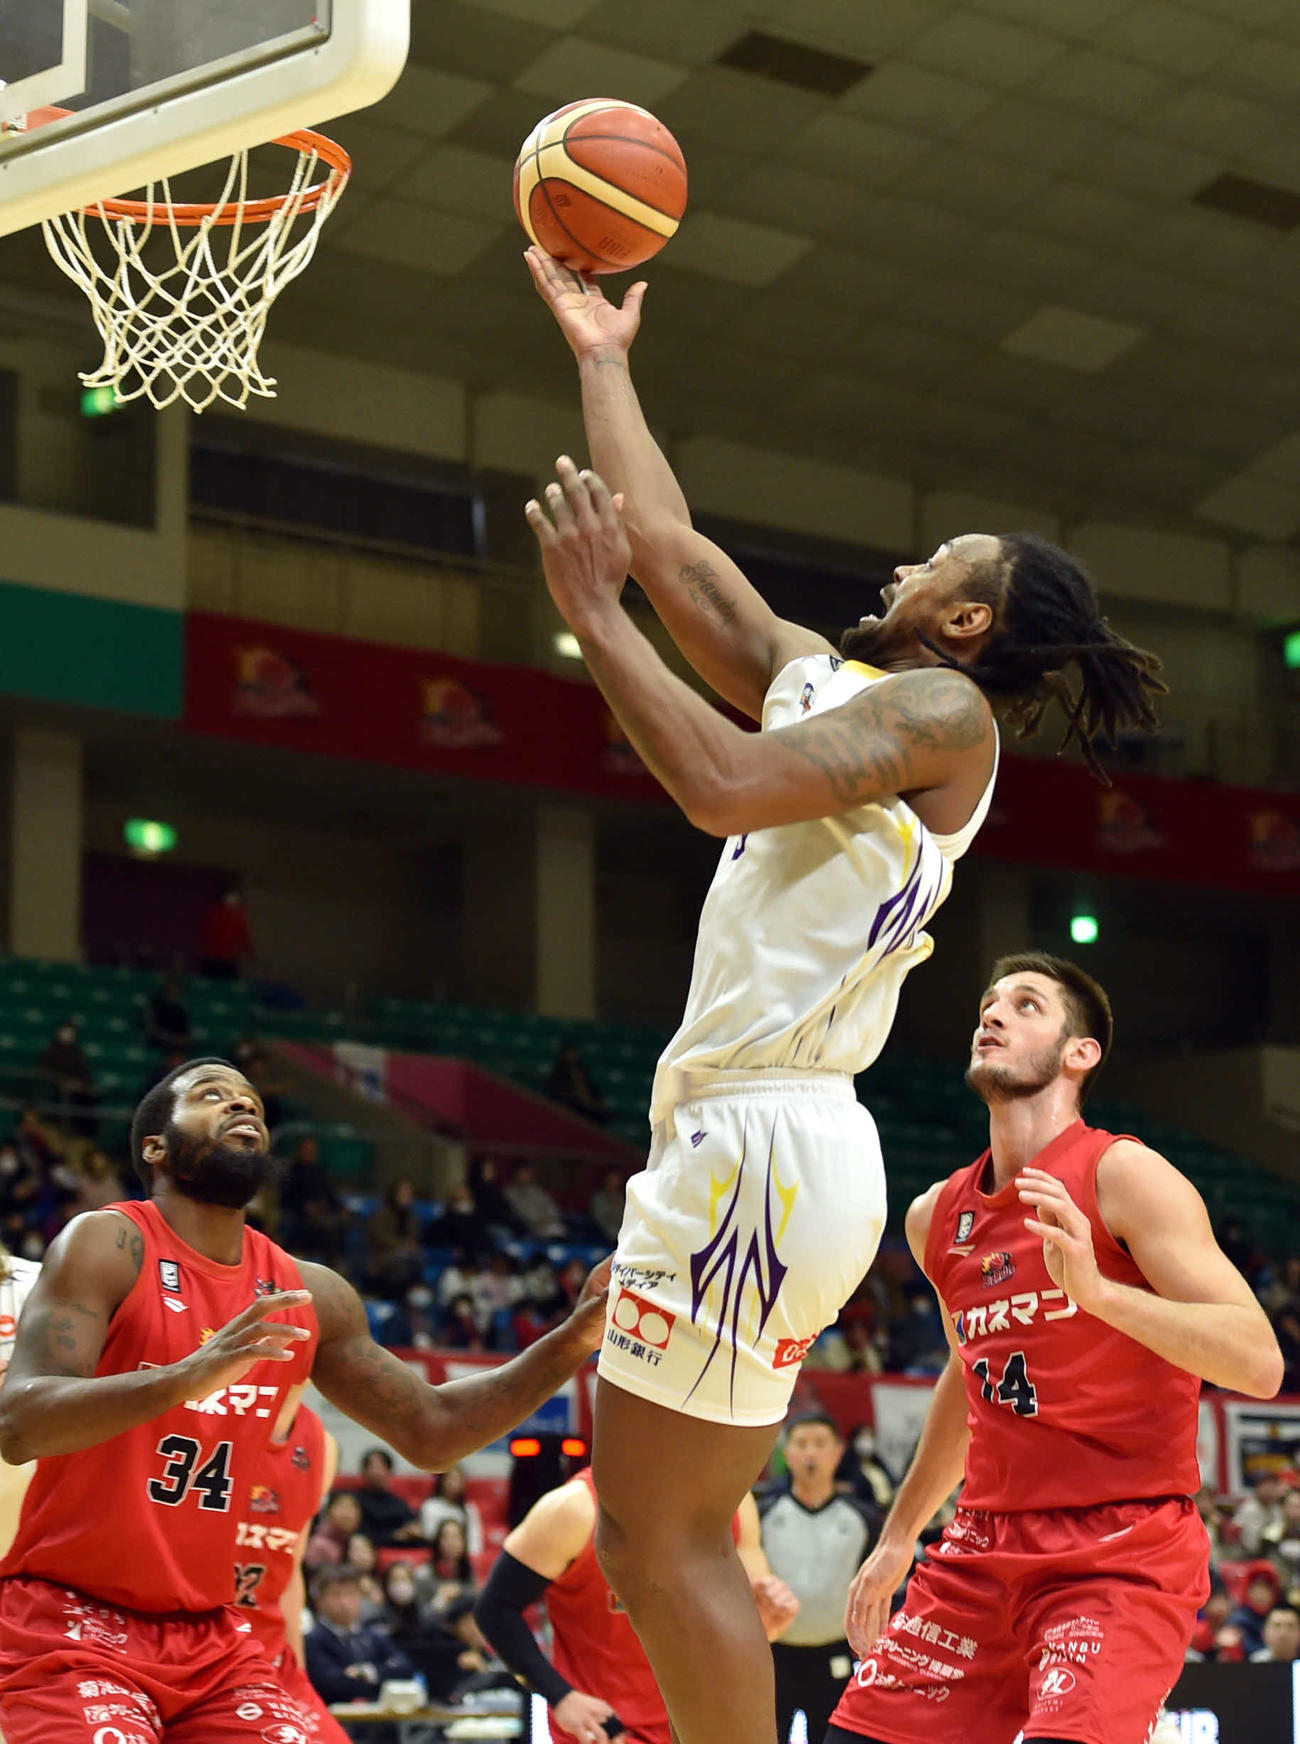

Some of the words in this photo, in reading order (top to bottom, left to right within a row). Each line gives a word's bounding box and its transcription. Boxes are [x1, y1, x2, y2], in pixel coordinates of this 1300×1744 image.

[607, 1328, 663, 1367] 山形銀行
[972, 1350, 1039, 1417] 14
[146, 1434, 234, 1513] 34
